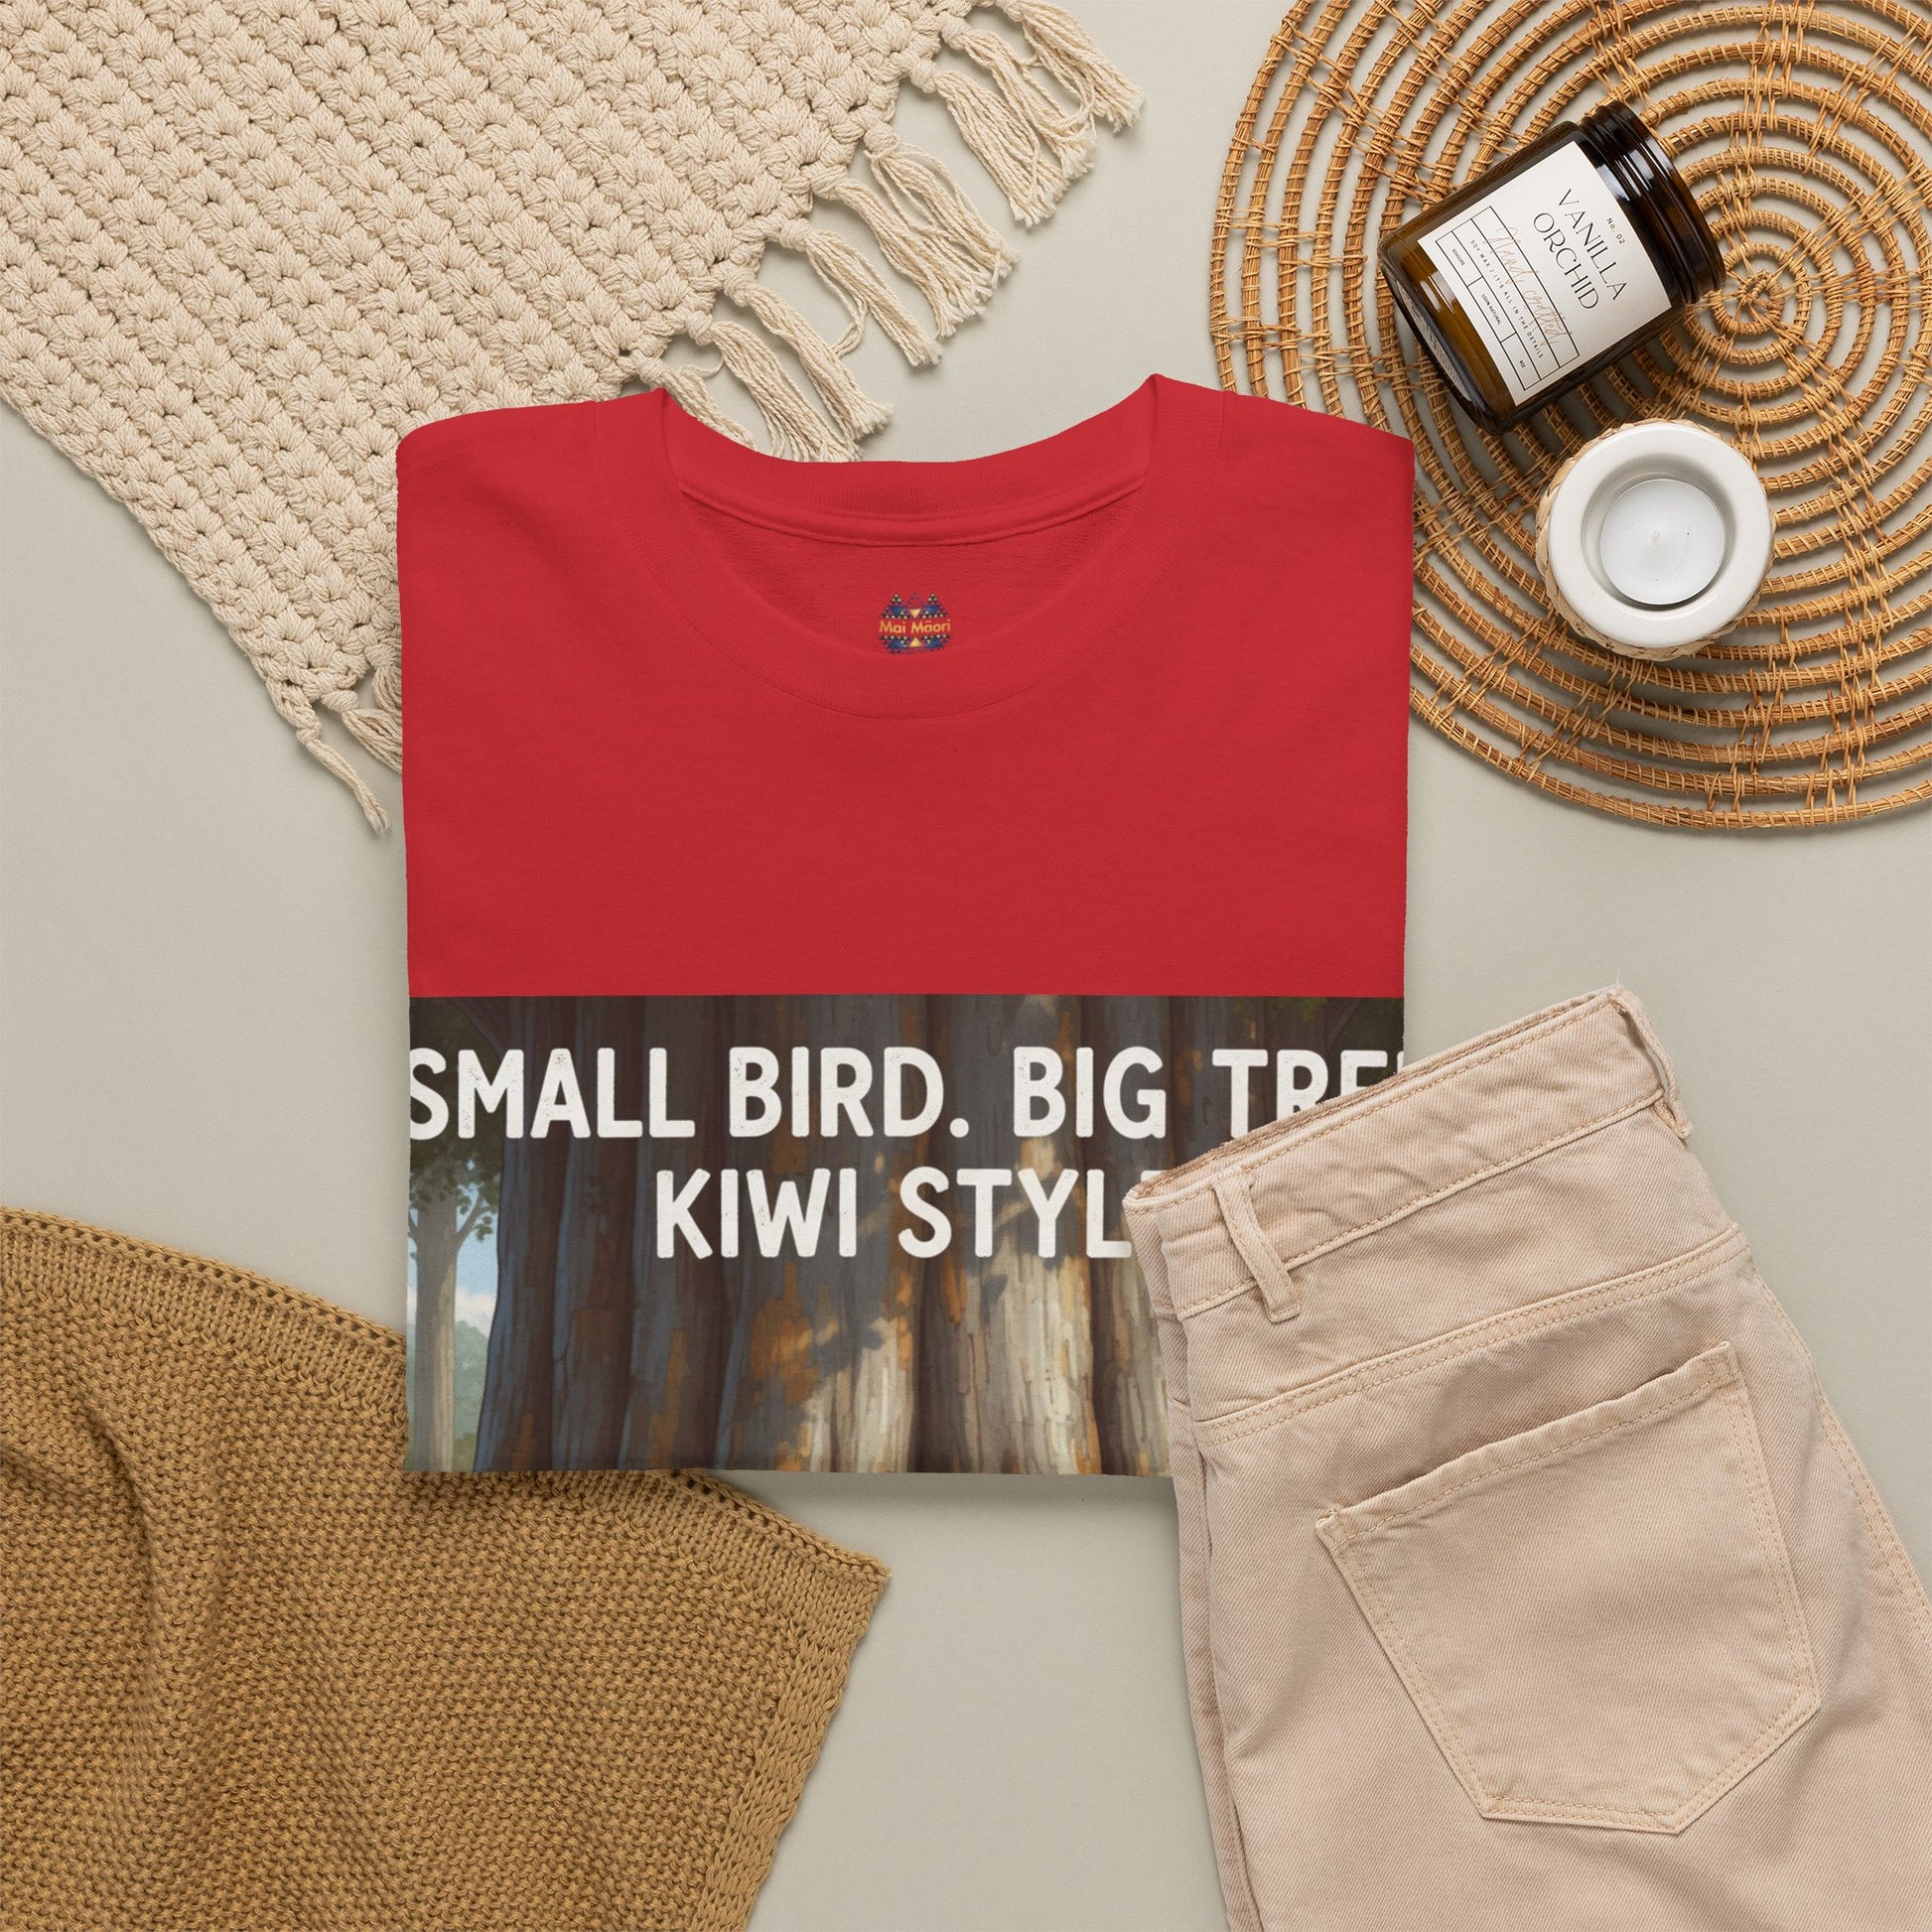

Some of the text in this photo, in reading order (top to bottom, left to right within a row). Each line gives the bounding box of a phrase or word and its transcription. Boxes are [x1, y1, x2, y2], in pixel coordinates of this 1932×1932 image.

[1534, 212, 1599, 309] ORCHID
[1558, 189, 1627, 300] VANILLA
[1606, 217, 1625, 245] No. 02
[1470, 239, 1480, 251] SOY
[1480, 253, 1490, 267] WAX
[1493, 274, 1504, 289] IT'S
[1503, 291, 1513, 304] ALL
[1512, 306, 1520, 315] IN
[1519, 316, 1529, 330] THE
[1527, 331, 1544, 358] DETAILS
[879, 620, 906, 633] Mai
[409, 1047, 695, 1140] SMALL
[729, 1046, 970, 1139] BIRD.
[1013, 1045, 1167, 1140] BIG
[656, 1166, 1170, 1259] KIWI STYL
